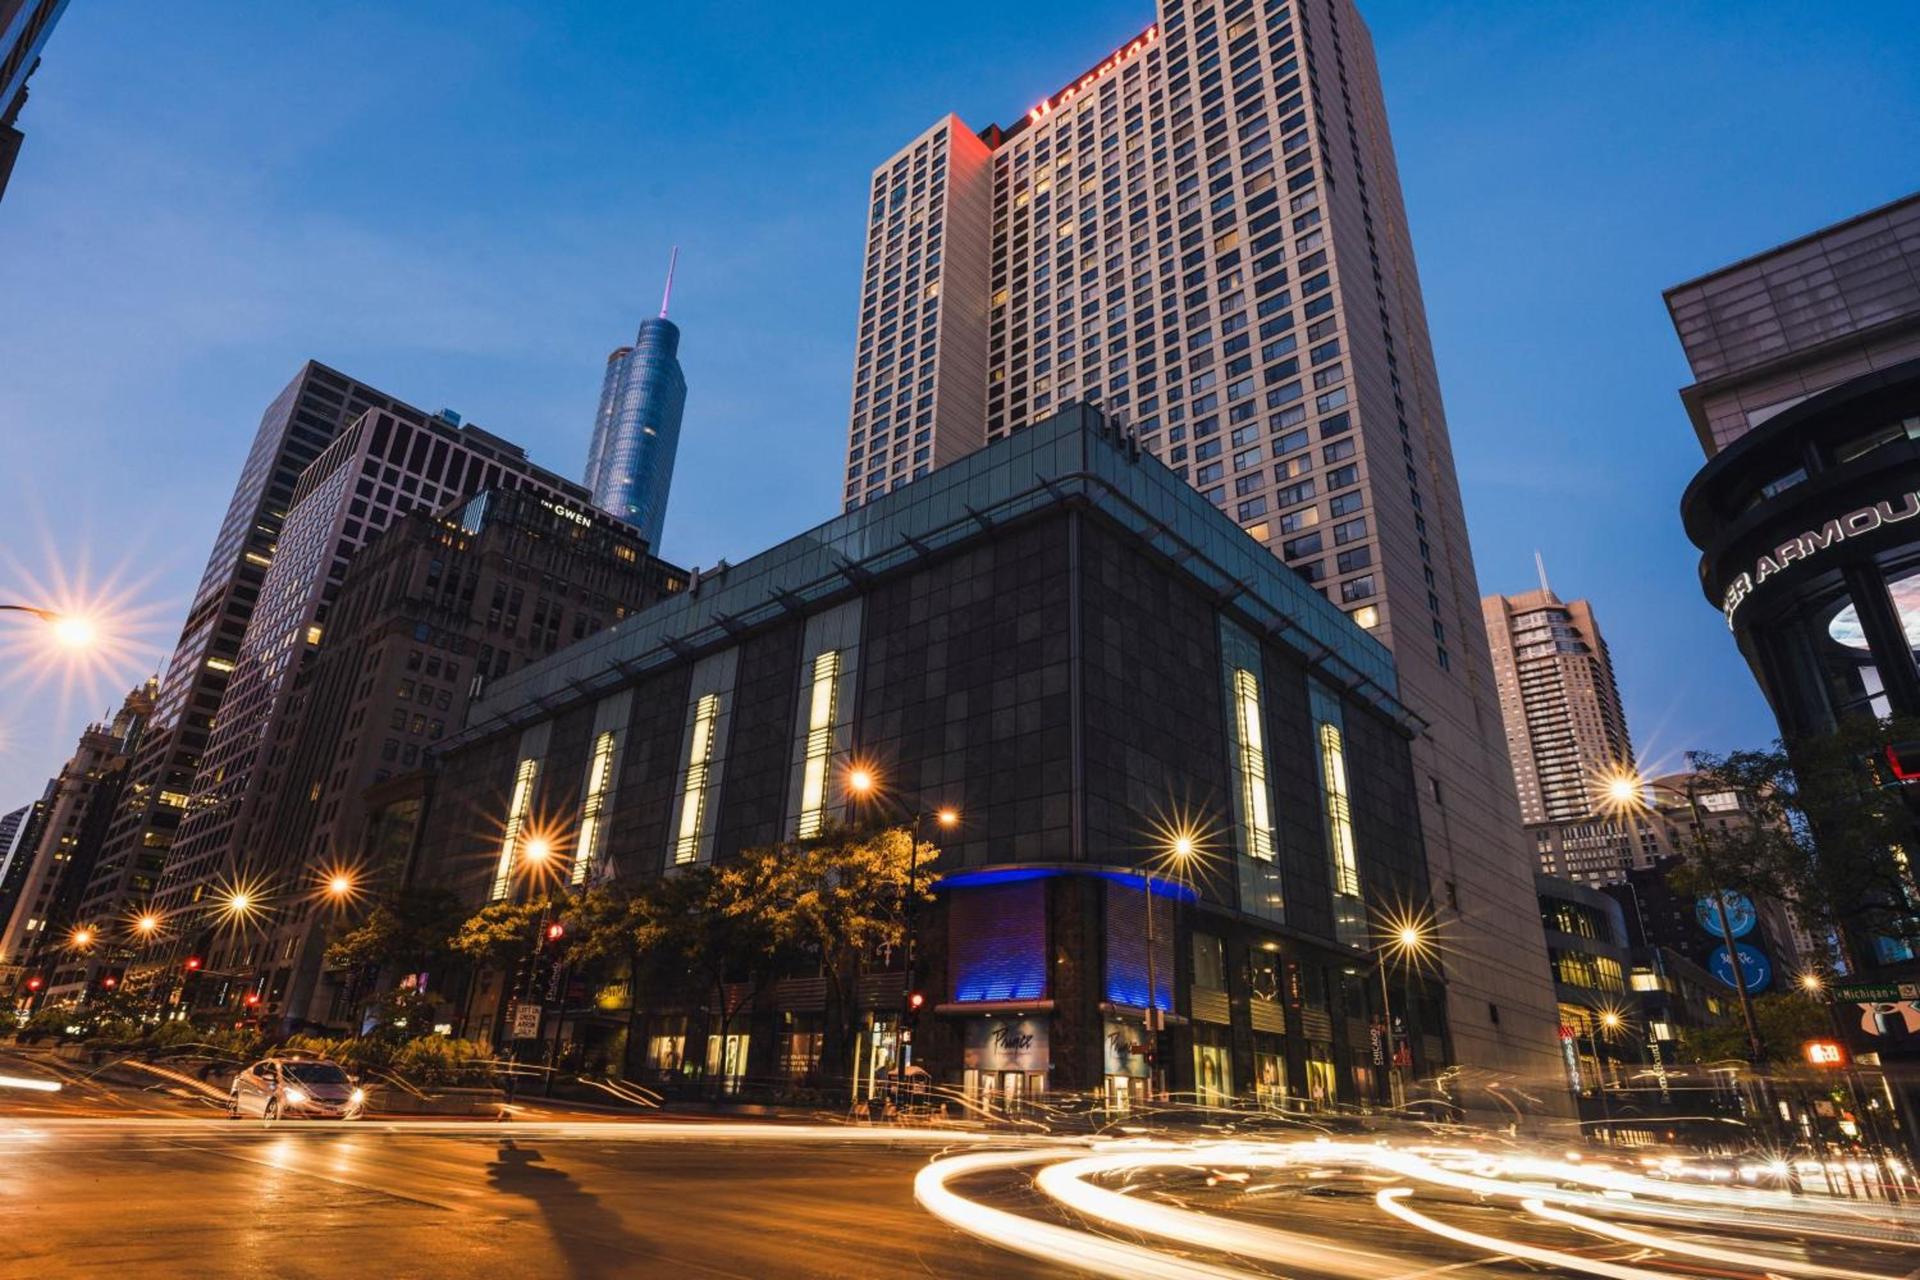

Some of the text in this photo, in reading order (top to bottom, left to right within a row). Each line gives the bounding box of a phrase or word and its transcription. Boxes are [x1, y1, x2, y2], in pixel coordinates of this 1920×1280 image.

[555, 505, 591, 528] GWEN
[1756, 490, 1920, 584] ARMOU
[1842, 988, 1889, 1000] Michigan
